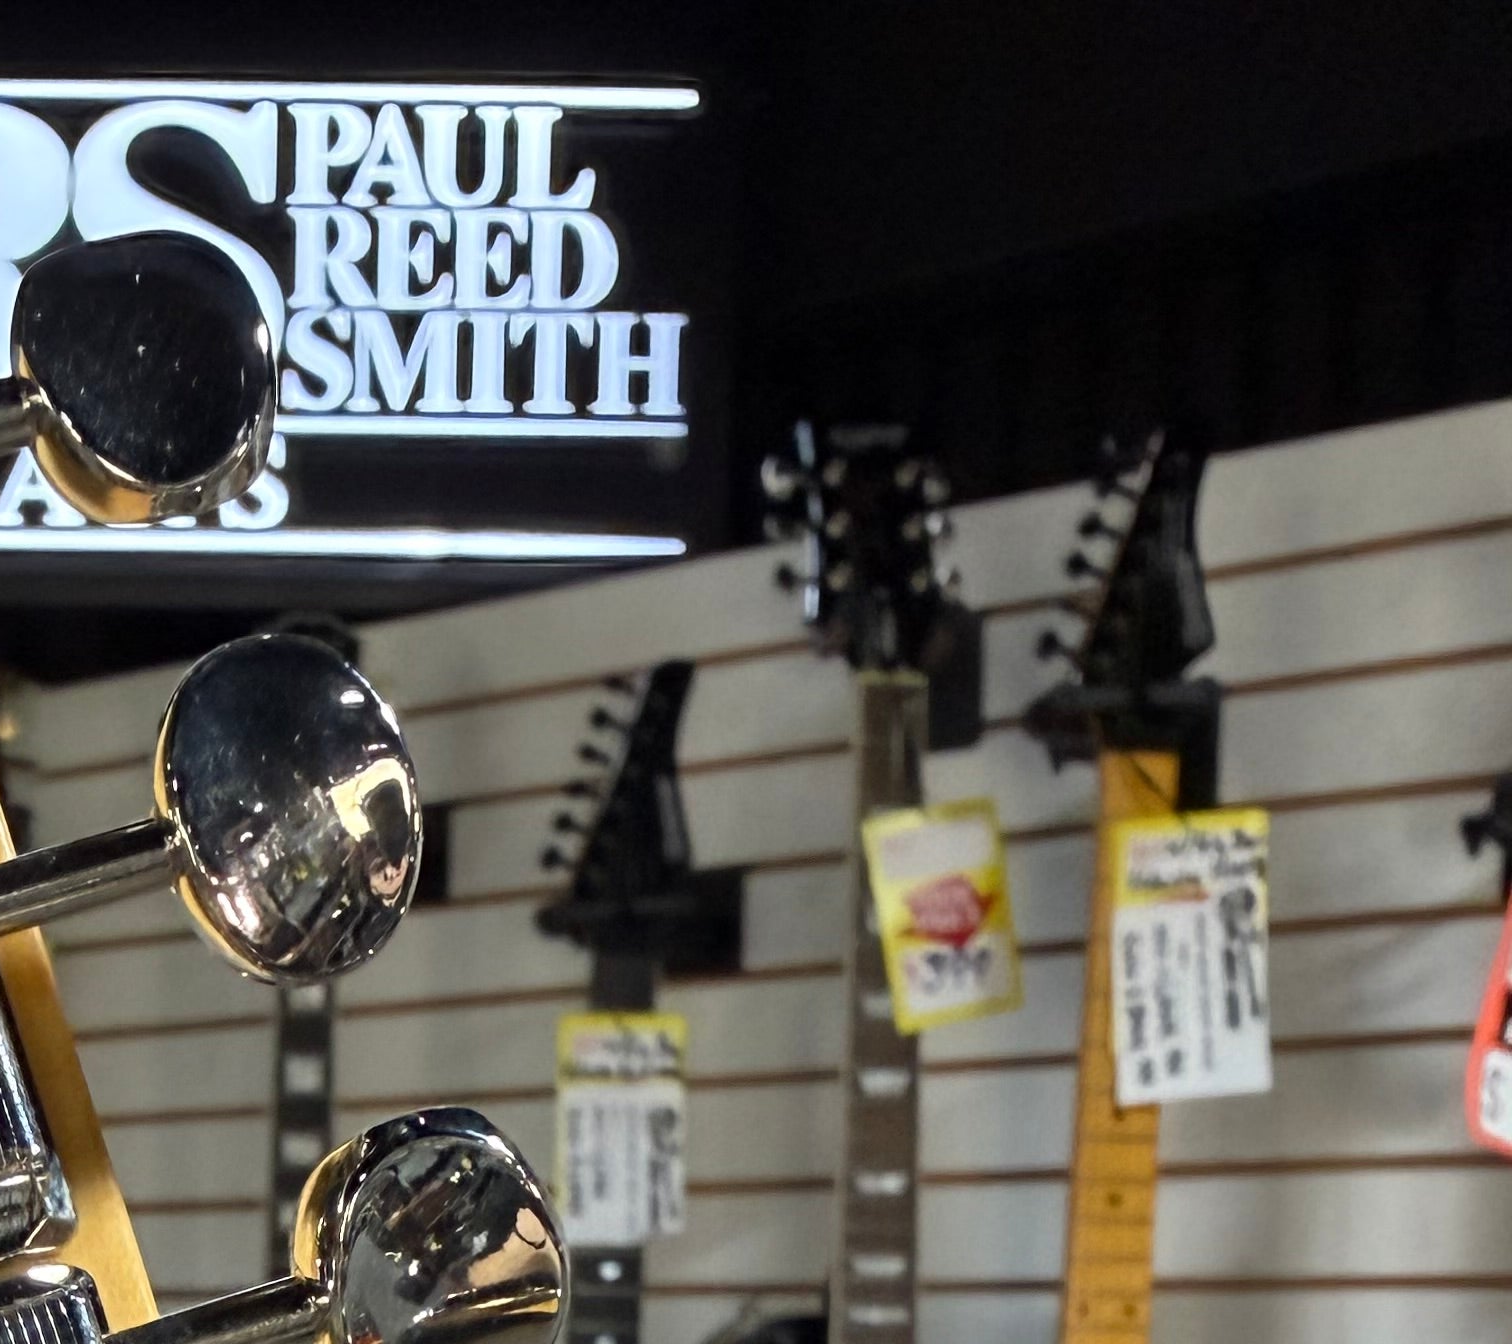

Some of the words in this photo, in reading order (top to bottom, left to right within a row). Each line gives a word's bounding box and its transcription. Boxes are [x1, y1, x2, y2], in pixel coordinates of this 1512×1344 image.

[286, 102, 596, 209] PAUL
[287, 206, 619, 310] REED
[281, 308, 689, 416] SMITH
